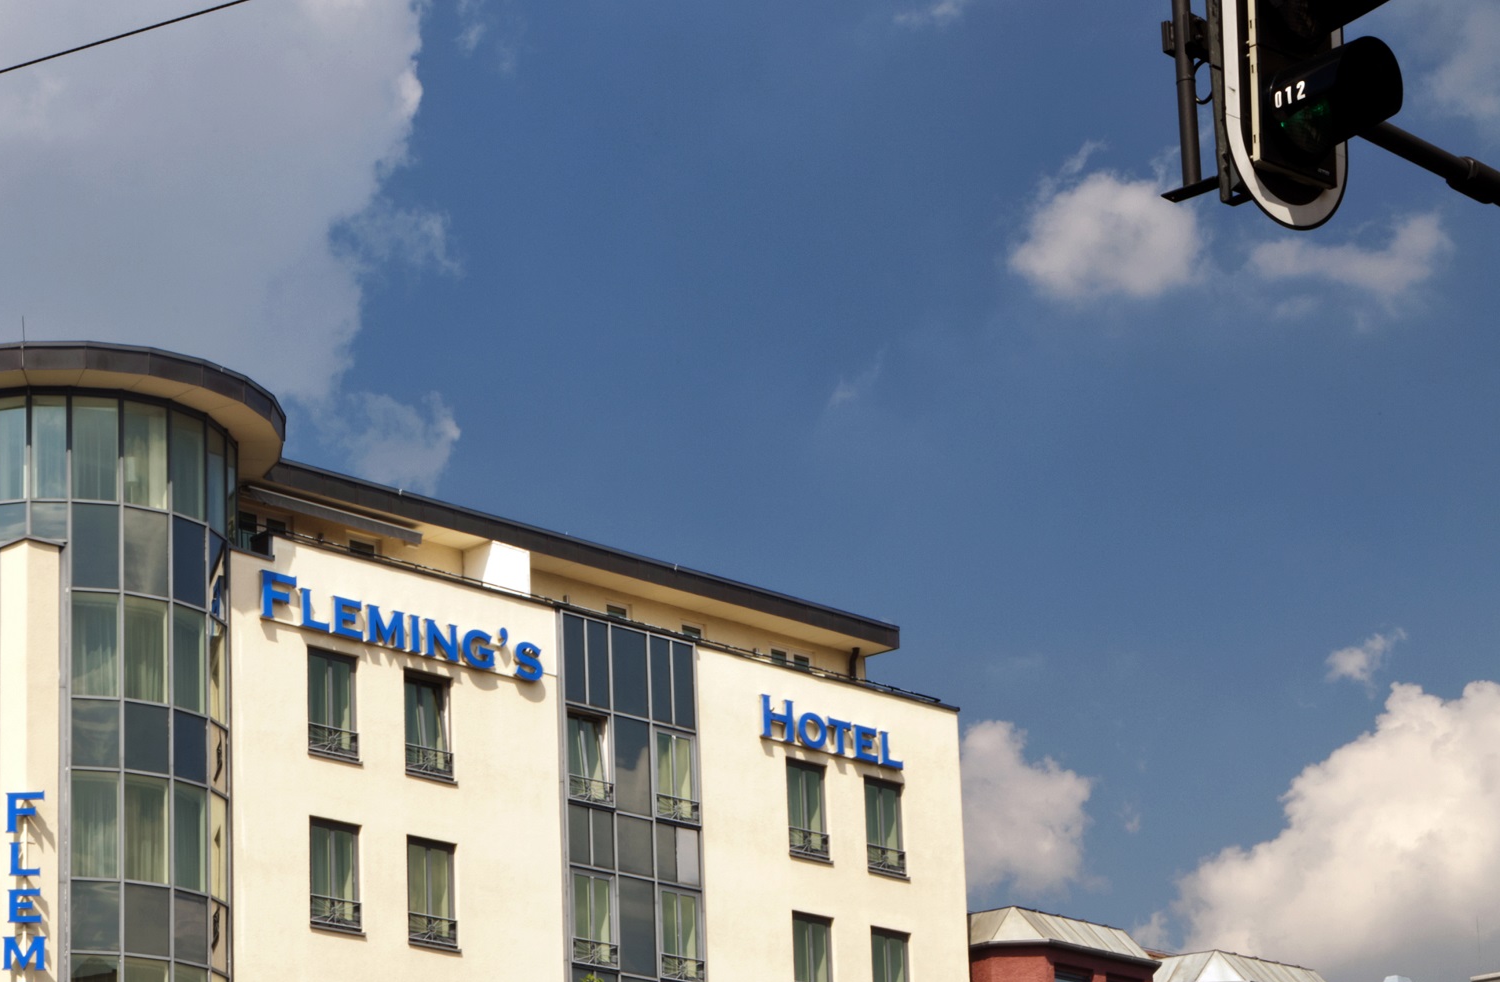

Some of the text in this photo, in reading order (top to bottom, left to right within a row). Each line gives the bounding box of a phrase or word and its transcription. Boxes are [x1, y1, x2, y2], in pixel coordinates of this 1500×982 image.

[1273, 80, 1306, 109] 012
[262, 569, 543, 682] FLEMING'S
[761, 693, 903, 769] HOTEL
